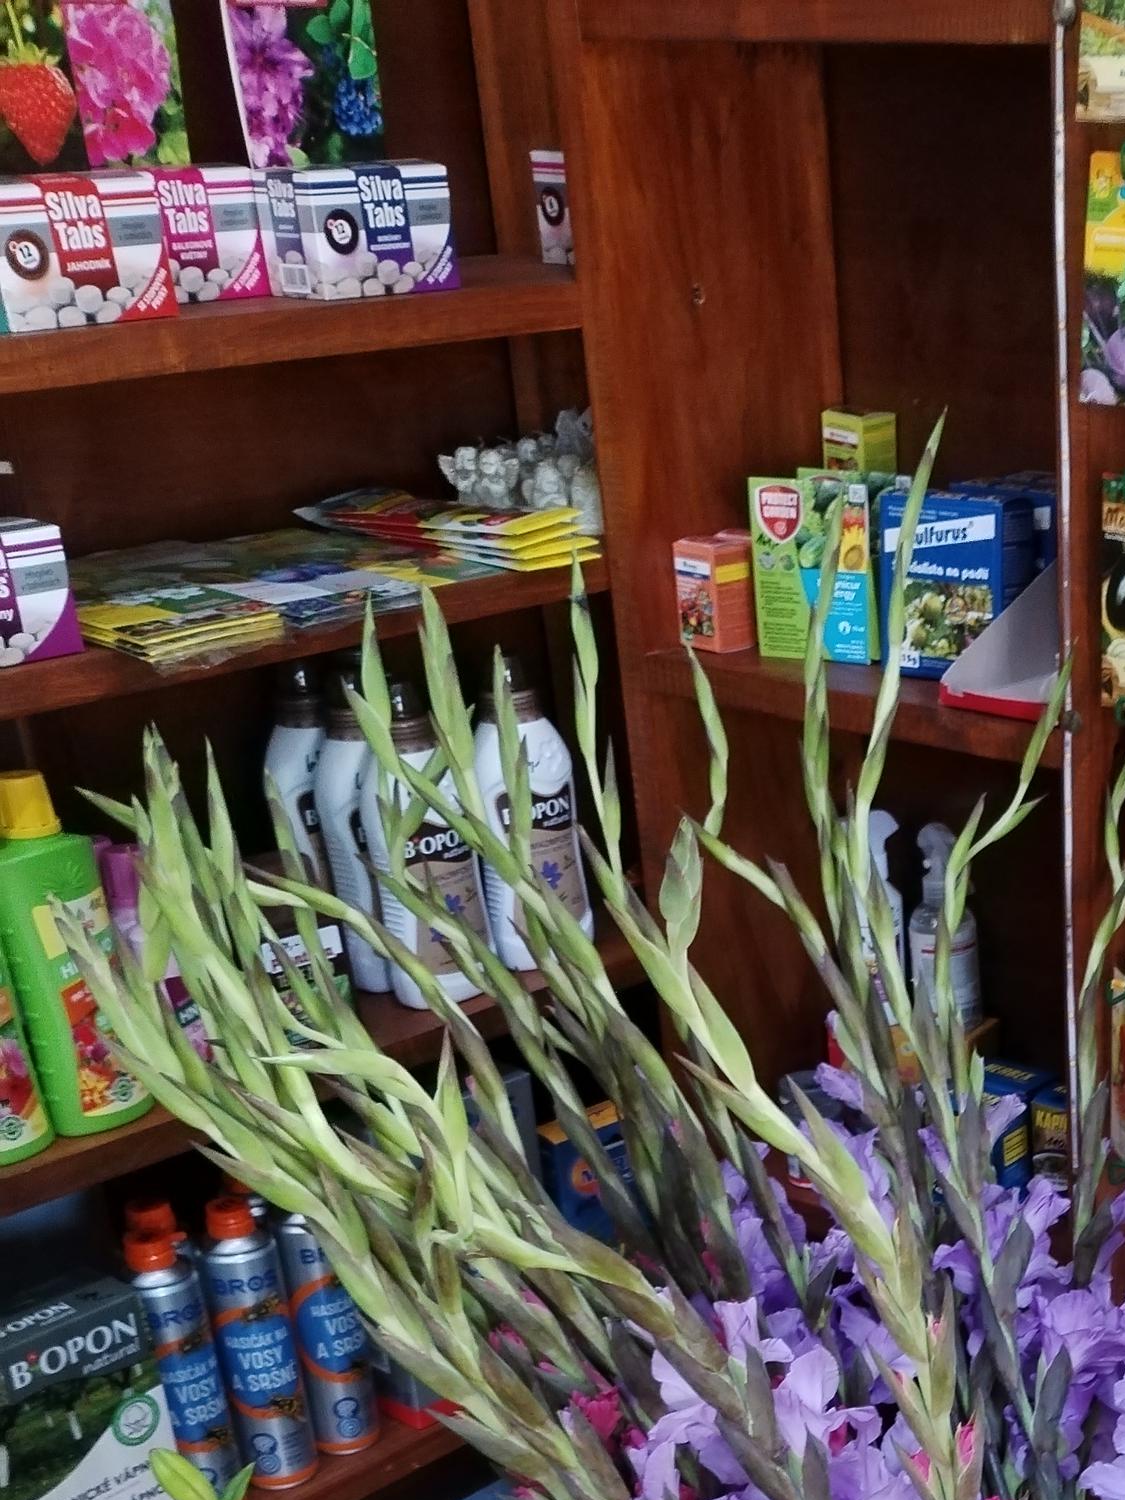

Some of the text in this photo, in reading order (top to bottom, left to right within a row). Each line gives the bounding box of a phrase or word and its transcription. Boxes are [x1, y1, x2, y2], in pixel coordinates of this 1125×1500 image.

[157, 180, 207, 207] Silva
[266, 179, 295, 200] Silva
[357, 175, 404, 202] Silva
[44, 191, 101, 221] Silva
[364, 202, 406, 229] Tabs
[164, 207, 209, 235] Tabs
[336, 223, 346, 234] 12
[54, 221, 106, 251] Tabs
[19, 244, 33, 260] 12
[914, 526, 969, 546] ulfurus
[214, 1268, 277, 1296] BROS
[324, 1312, 358, 1336] VOS
[236, 1344, 284, 1371] VOSY
[174, 1377, 217, 1405] VOSY
[232, 1373, 245, 1391] A
[113, 1459, 151, 1486] VÁPN
